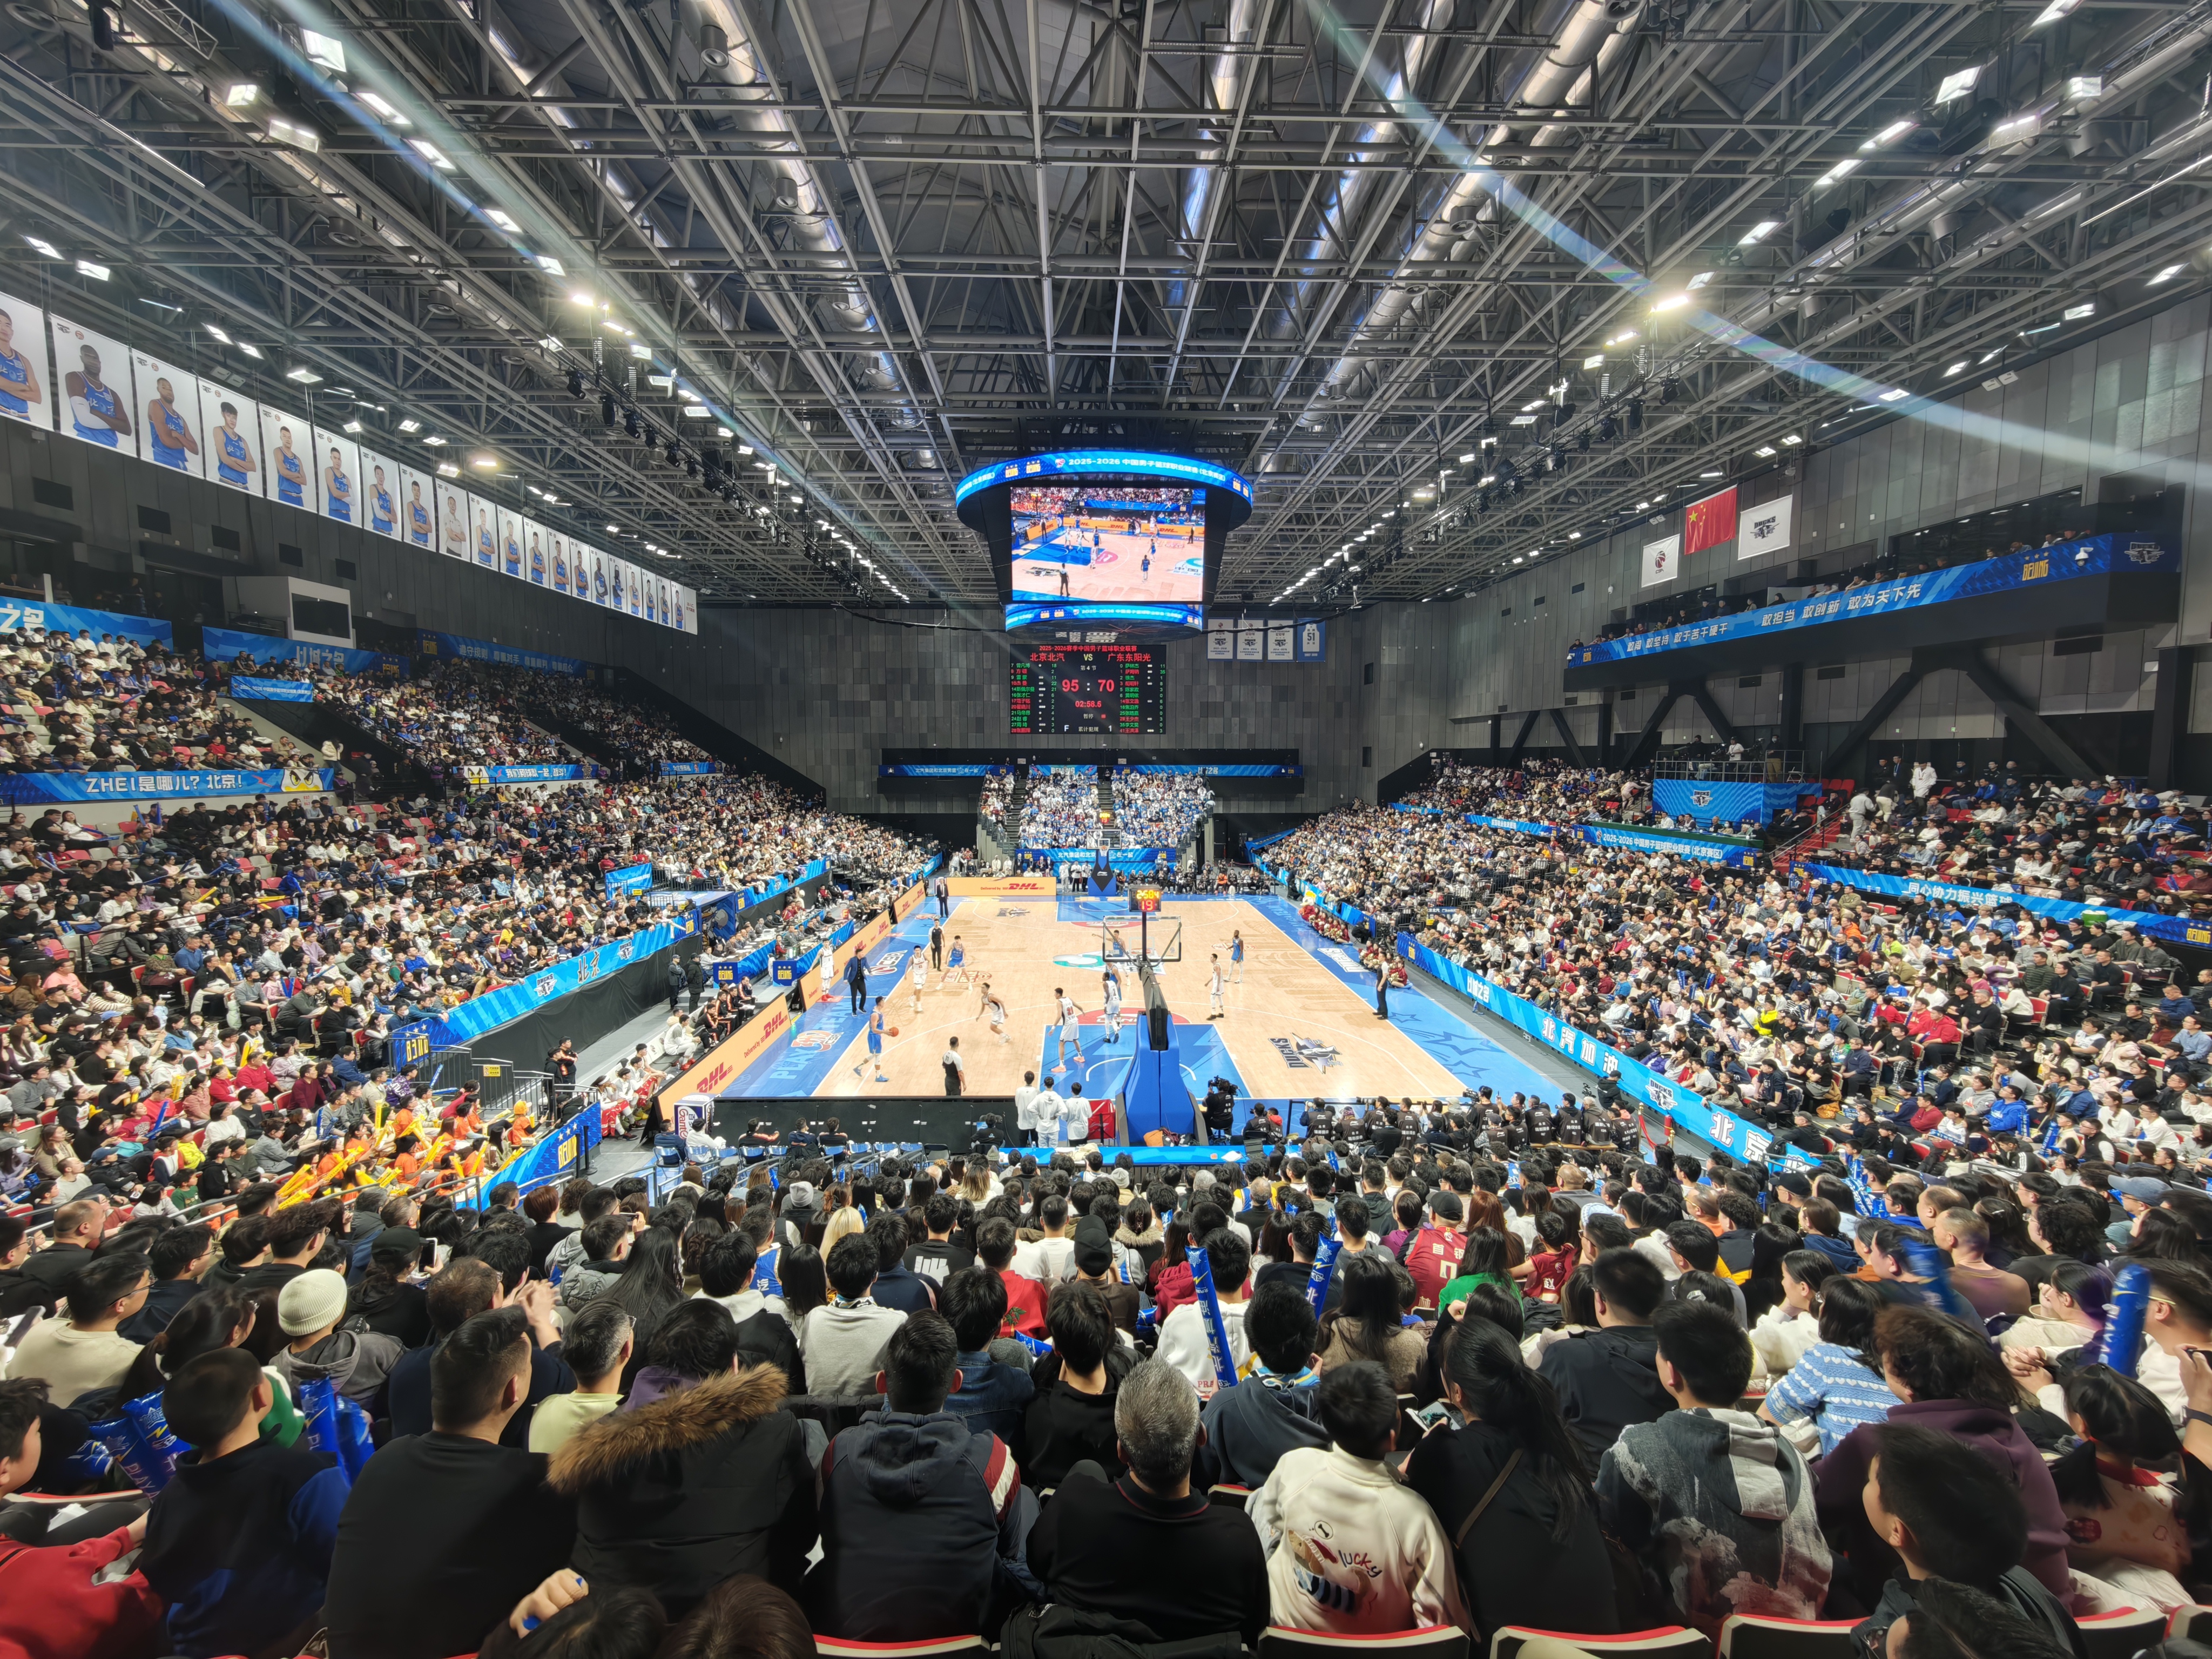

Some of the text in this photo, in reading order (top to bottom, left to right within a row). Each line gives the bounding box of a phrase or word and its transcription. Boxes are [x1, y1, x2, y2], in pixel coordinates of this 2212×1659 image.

[1069, 457, 1120, 466] 2025-2026
[1122, 458, 1199, 474] 中国男子篮球职业联赛
[1754, 516, 1776, 529] DUCKS
[2022, 559, 2049, 581] BEIJING
[1627, 583, 1922, 652] 敢闯 敢坚持 敢于苦干硬干 敢担当 敢创新 敢为天下先
[1307, 632, 1316, 642] 51
[1030, 652, 1151, 662] 北京北汽 VS 广东东阳光
[1062, 679, 1079, 692] 95
[1098, 679, 1115, 692] 70
[85, 774, 243, 793] ZHEI是哪儿？ 北京！
[1603, 833, 1633, 846] 2025-2026
[1634, 839, 1690, 855] 中国男子篮球职业联赛
[1908, 883, 2013, 905] 同心协力振兴篮球
[1141, 900, 1154, 911] 19
[2186, 928, 2211, 944] BEIJING
[578, 951, 601, 984] 北京
[876, 949, 908, 967] CBA
[537, 974, 554, 986] DUCKS
[718, 970, 733, 980] BEIJING
[778, 970, 792, 980] BEIJING
[1467, 975, 1490, 1003] 以城之名
[1066, 1006, 1074, 1016] 21
[744, 1043, 756, 1058] Delivered
[763, 1010, 785, 1041] DHL
[1268, 1037, 1312, 1069] DUCKS
[1542, 1016, 1619, 1075] 北汽加油
[769, 1048, 813, 1080] PLAY
[696, 1061, 728, 1093] DHL
[1649, 1078, 1674, 1099] DUCKS
[1338, 1549, 1383, 1578] lucky
